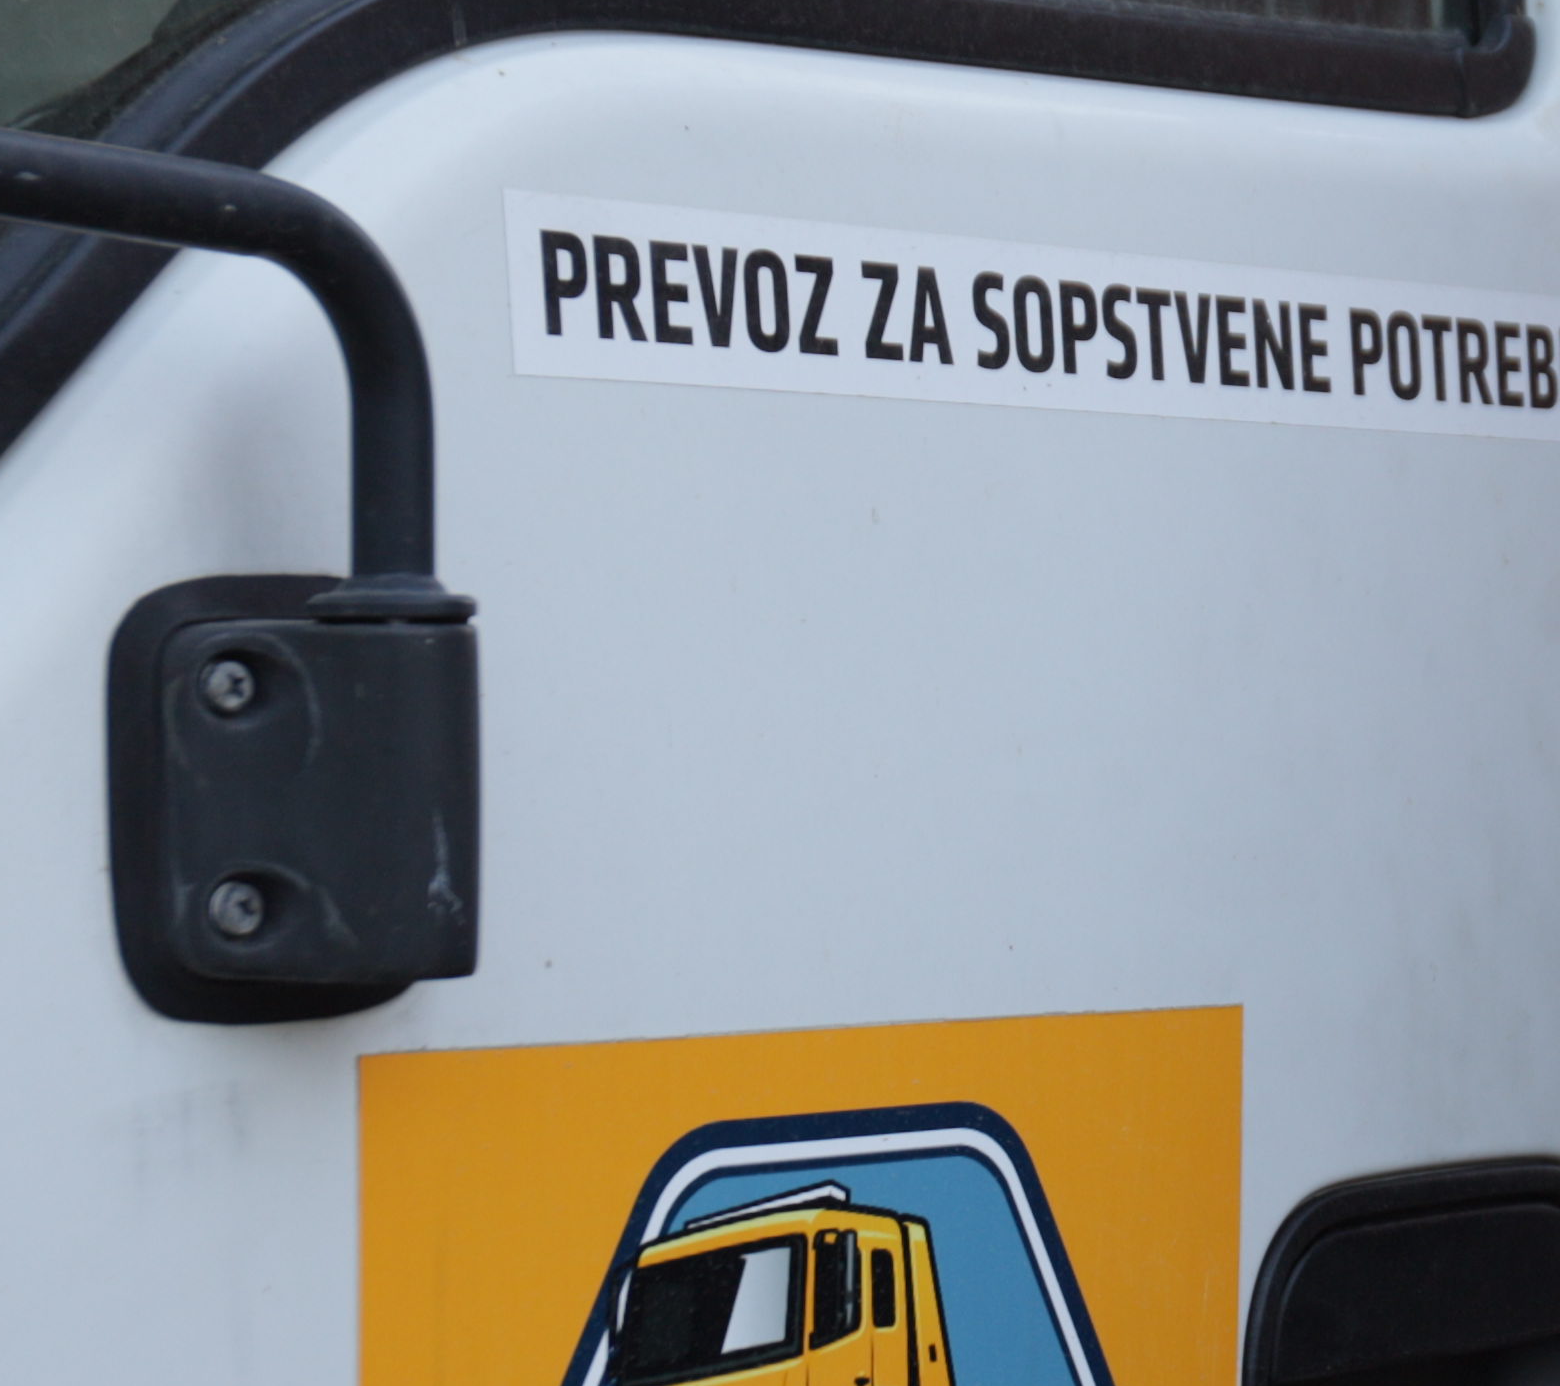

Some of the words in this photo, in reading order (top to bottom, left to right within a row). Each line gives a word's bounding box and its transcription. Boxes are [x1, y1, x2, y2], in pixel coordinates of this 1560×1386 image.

[539, 229, 840, 358] PREVOZ
[860, 260, 955, 366] ZA
[971, 271, 1333, 395] SOPSTVENE
